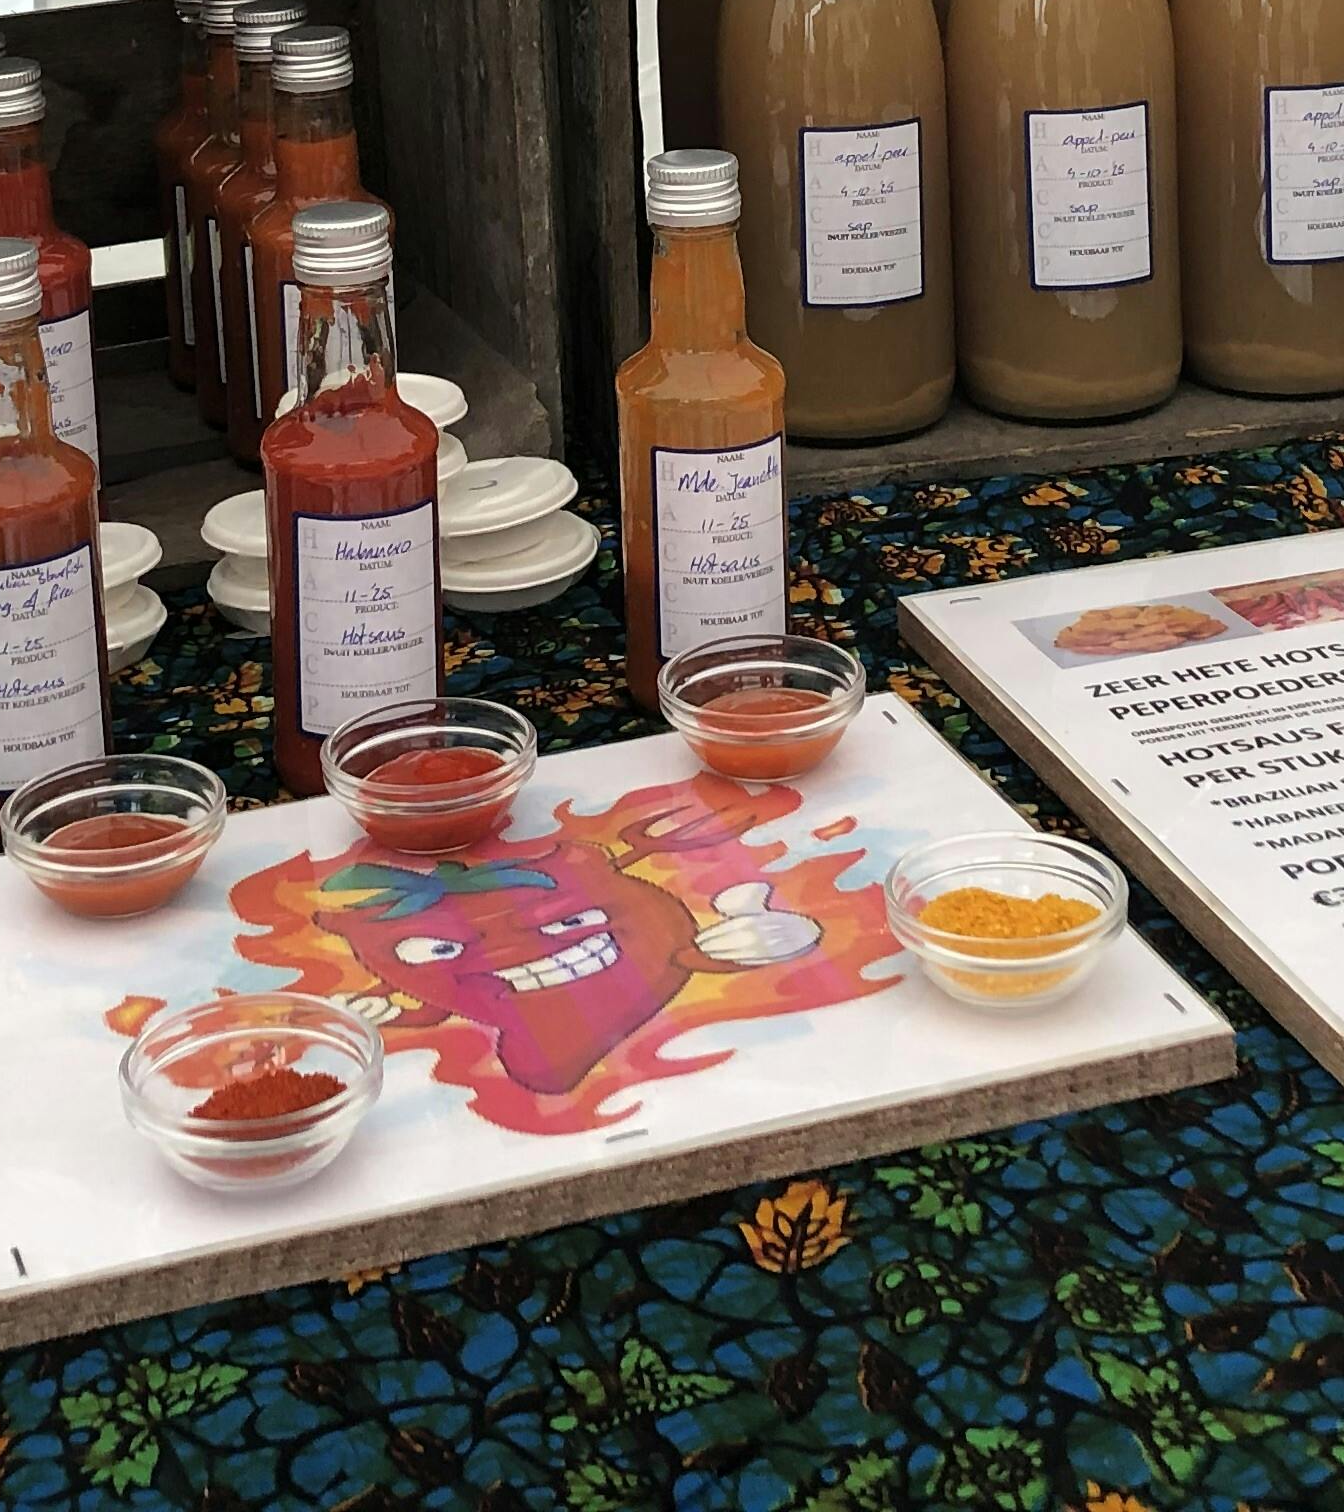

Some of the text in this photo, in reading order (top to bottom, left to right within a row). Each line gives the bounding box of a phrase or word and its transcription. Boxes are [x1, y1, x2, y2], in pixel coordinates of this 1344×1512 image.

[700, 614, 748, 626] HOUDBAAR
[1085, 674, 1170, 698] ZEER
[1172, 659, 1258, 683] HETE
[341, 687, 392, 699] HOUDBAAR
[1131, 719, 1208, 737] ONBESPOTEN
[1139, 732, 1186, 744] POEDER
[1187, 728, 1206, 736] UIT
[1208, 721, 1252, 733] TERZIET
[3, 737, 57, 752] HOUDBAAR
[1157, 727, 1323, 767] HOTSAUS
[1183, 765, 1255, 788] PER
